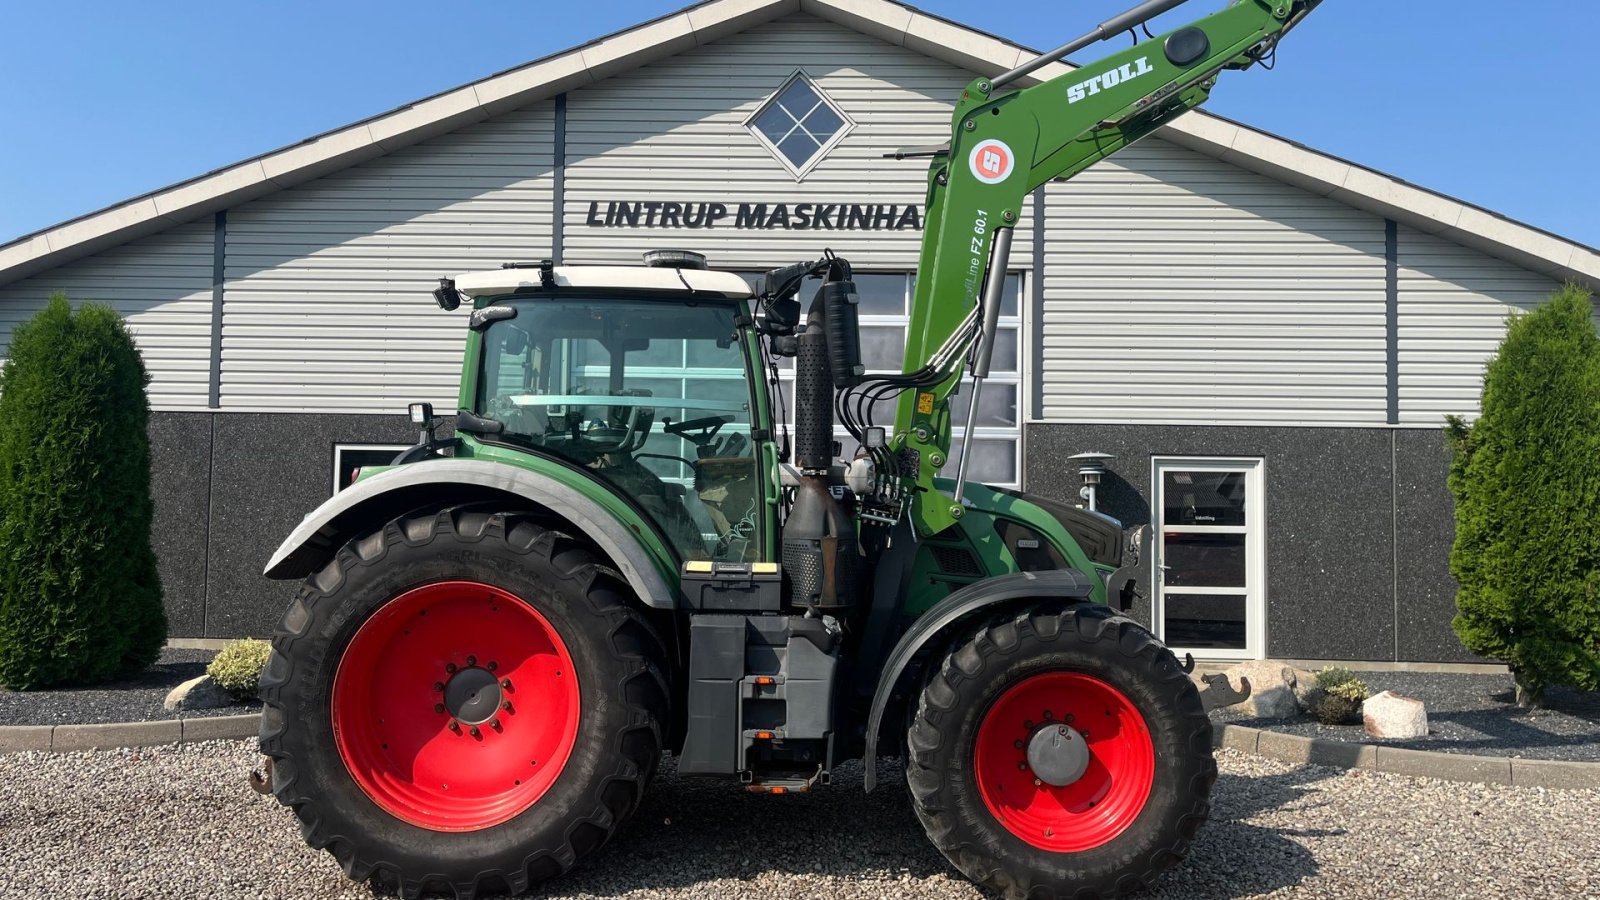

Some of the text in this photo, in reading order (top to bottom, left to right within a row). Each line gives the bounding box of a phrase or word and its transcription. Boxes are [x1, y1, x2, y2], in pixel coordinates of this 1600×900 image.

[1067, 56, 1154, 105] STOLL
[586, 201, 924, 231] LINTRUP MASKINHA
[974, 209, 988, 235] 60.1
[970, 236, 984, 255] FZ
